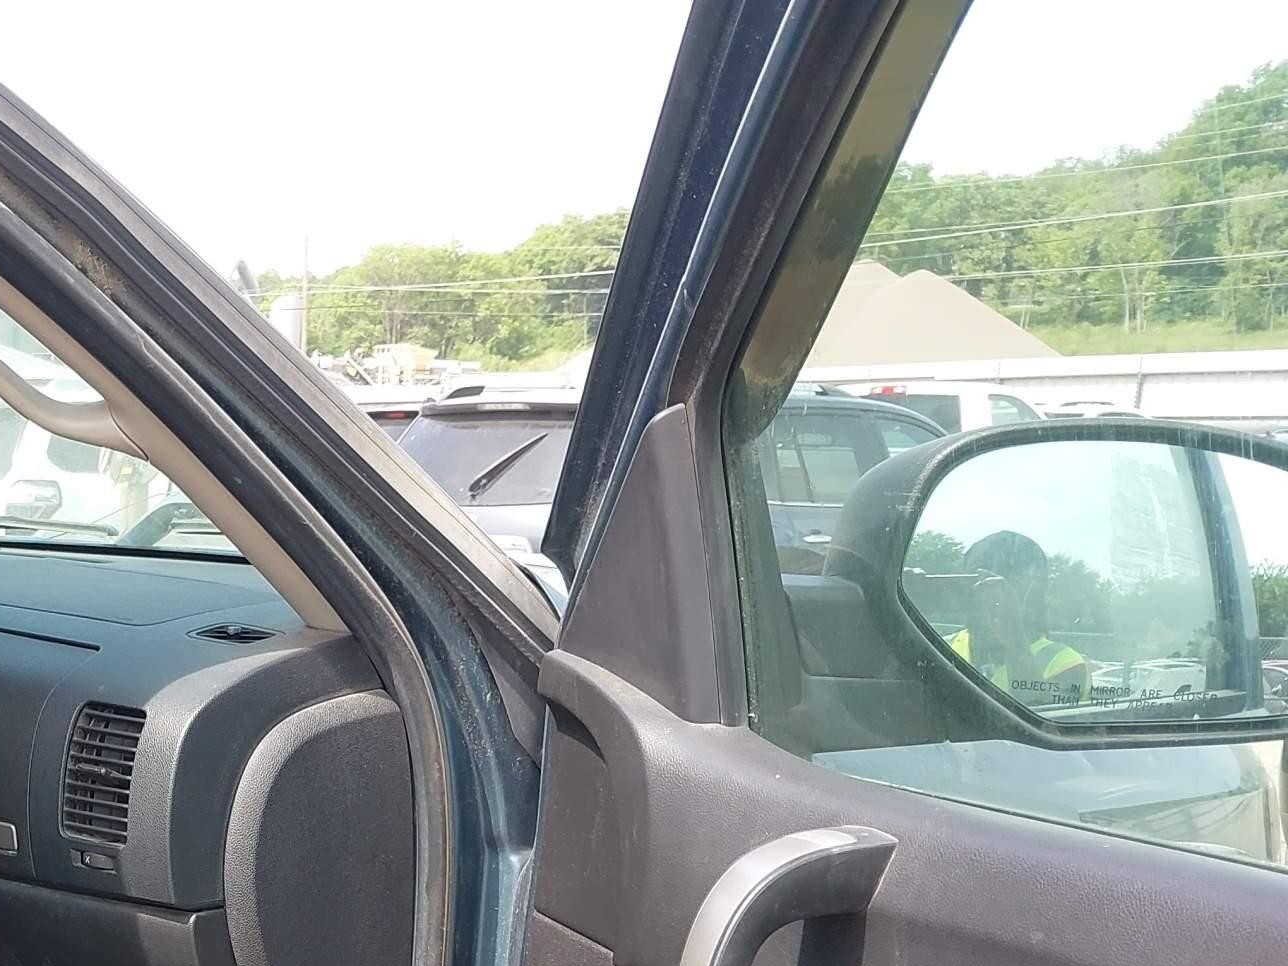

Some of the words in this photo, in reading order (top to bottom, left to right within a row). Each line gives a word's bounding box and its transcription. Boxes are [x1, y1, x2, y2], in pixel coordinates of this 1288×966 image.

[1011, 680, 1061, 693] OBJECTS
[1070, 683, 1081, 694] IN
[1091, 685, 1131, 697] MIRROR
[1140, 688, 1163, 699] ARE
[1051, 694, 1080, 707] THAN
